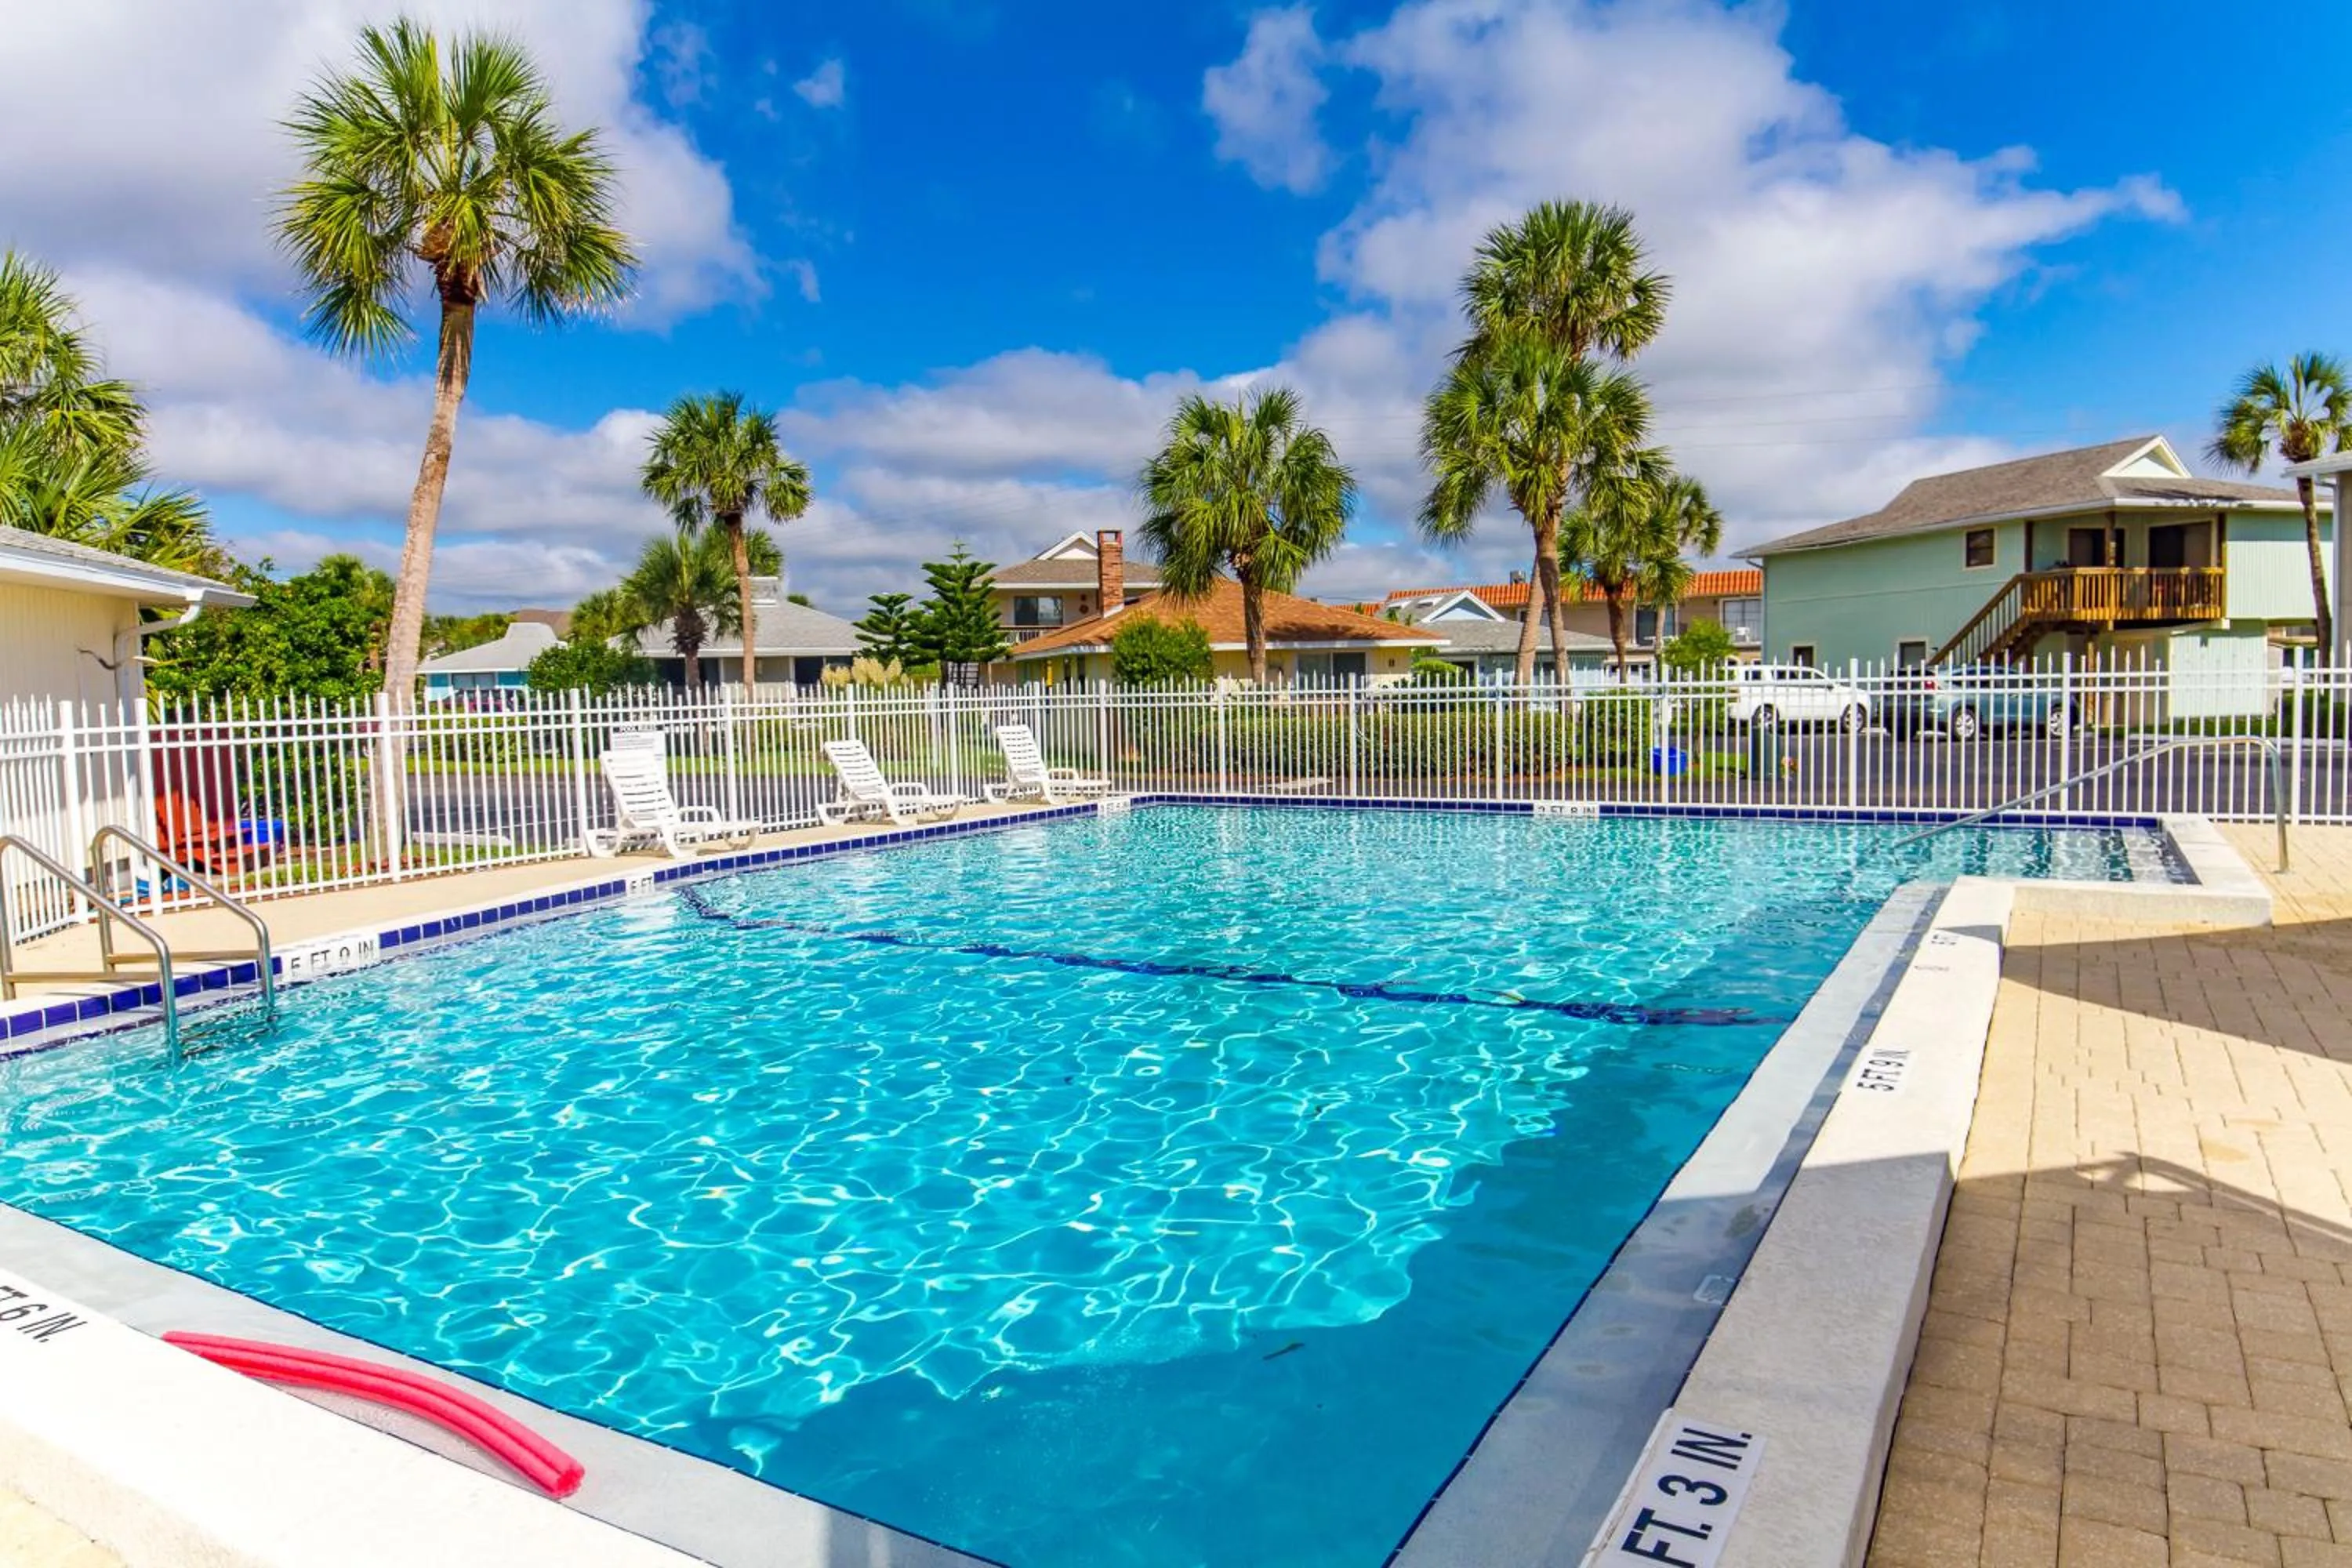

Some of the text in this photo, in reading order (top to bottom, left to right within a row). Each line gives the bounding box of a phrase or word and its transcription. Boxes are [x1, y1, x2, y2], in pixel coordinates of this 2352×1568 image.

[1857, 1082, 1894, 1091] 5
[0, 1304, 49, 1321] 6
[16, 1312, 88, 1343] IN.
[1621, 1427, 1753, 1568] FT. 3 IN.
